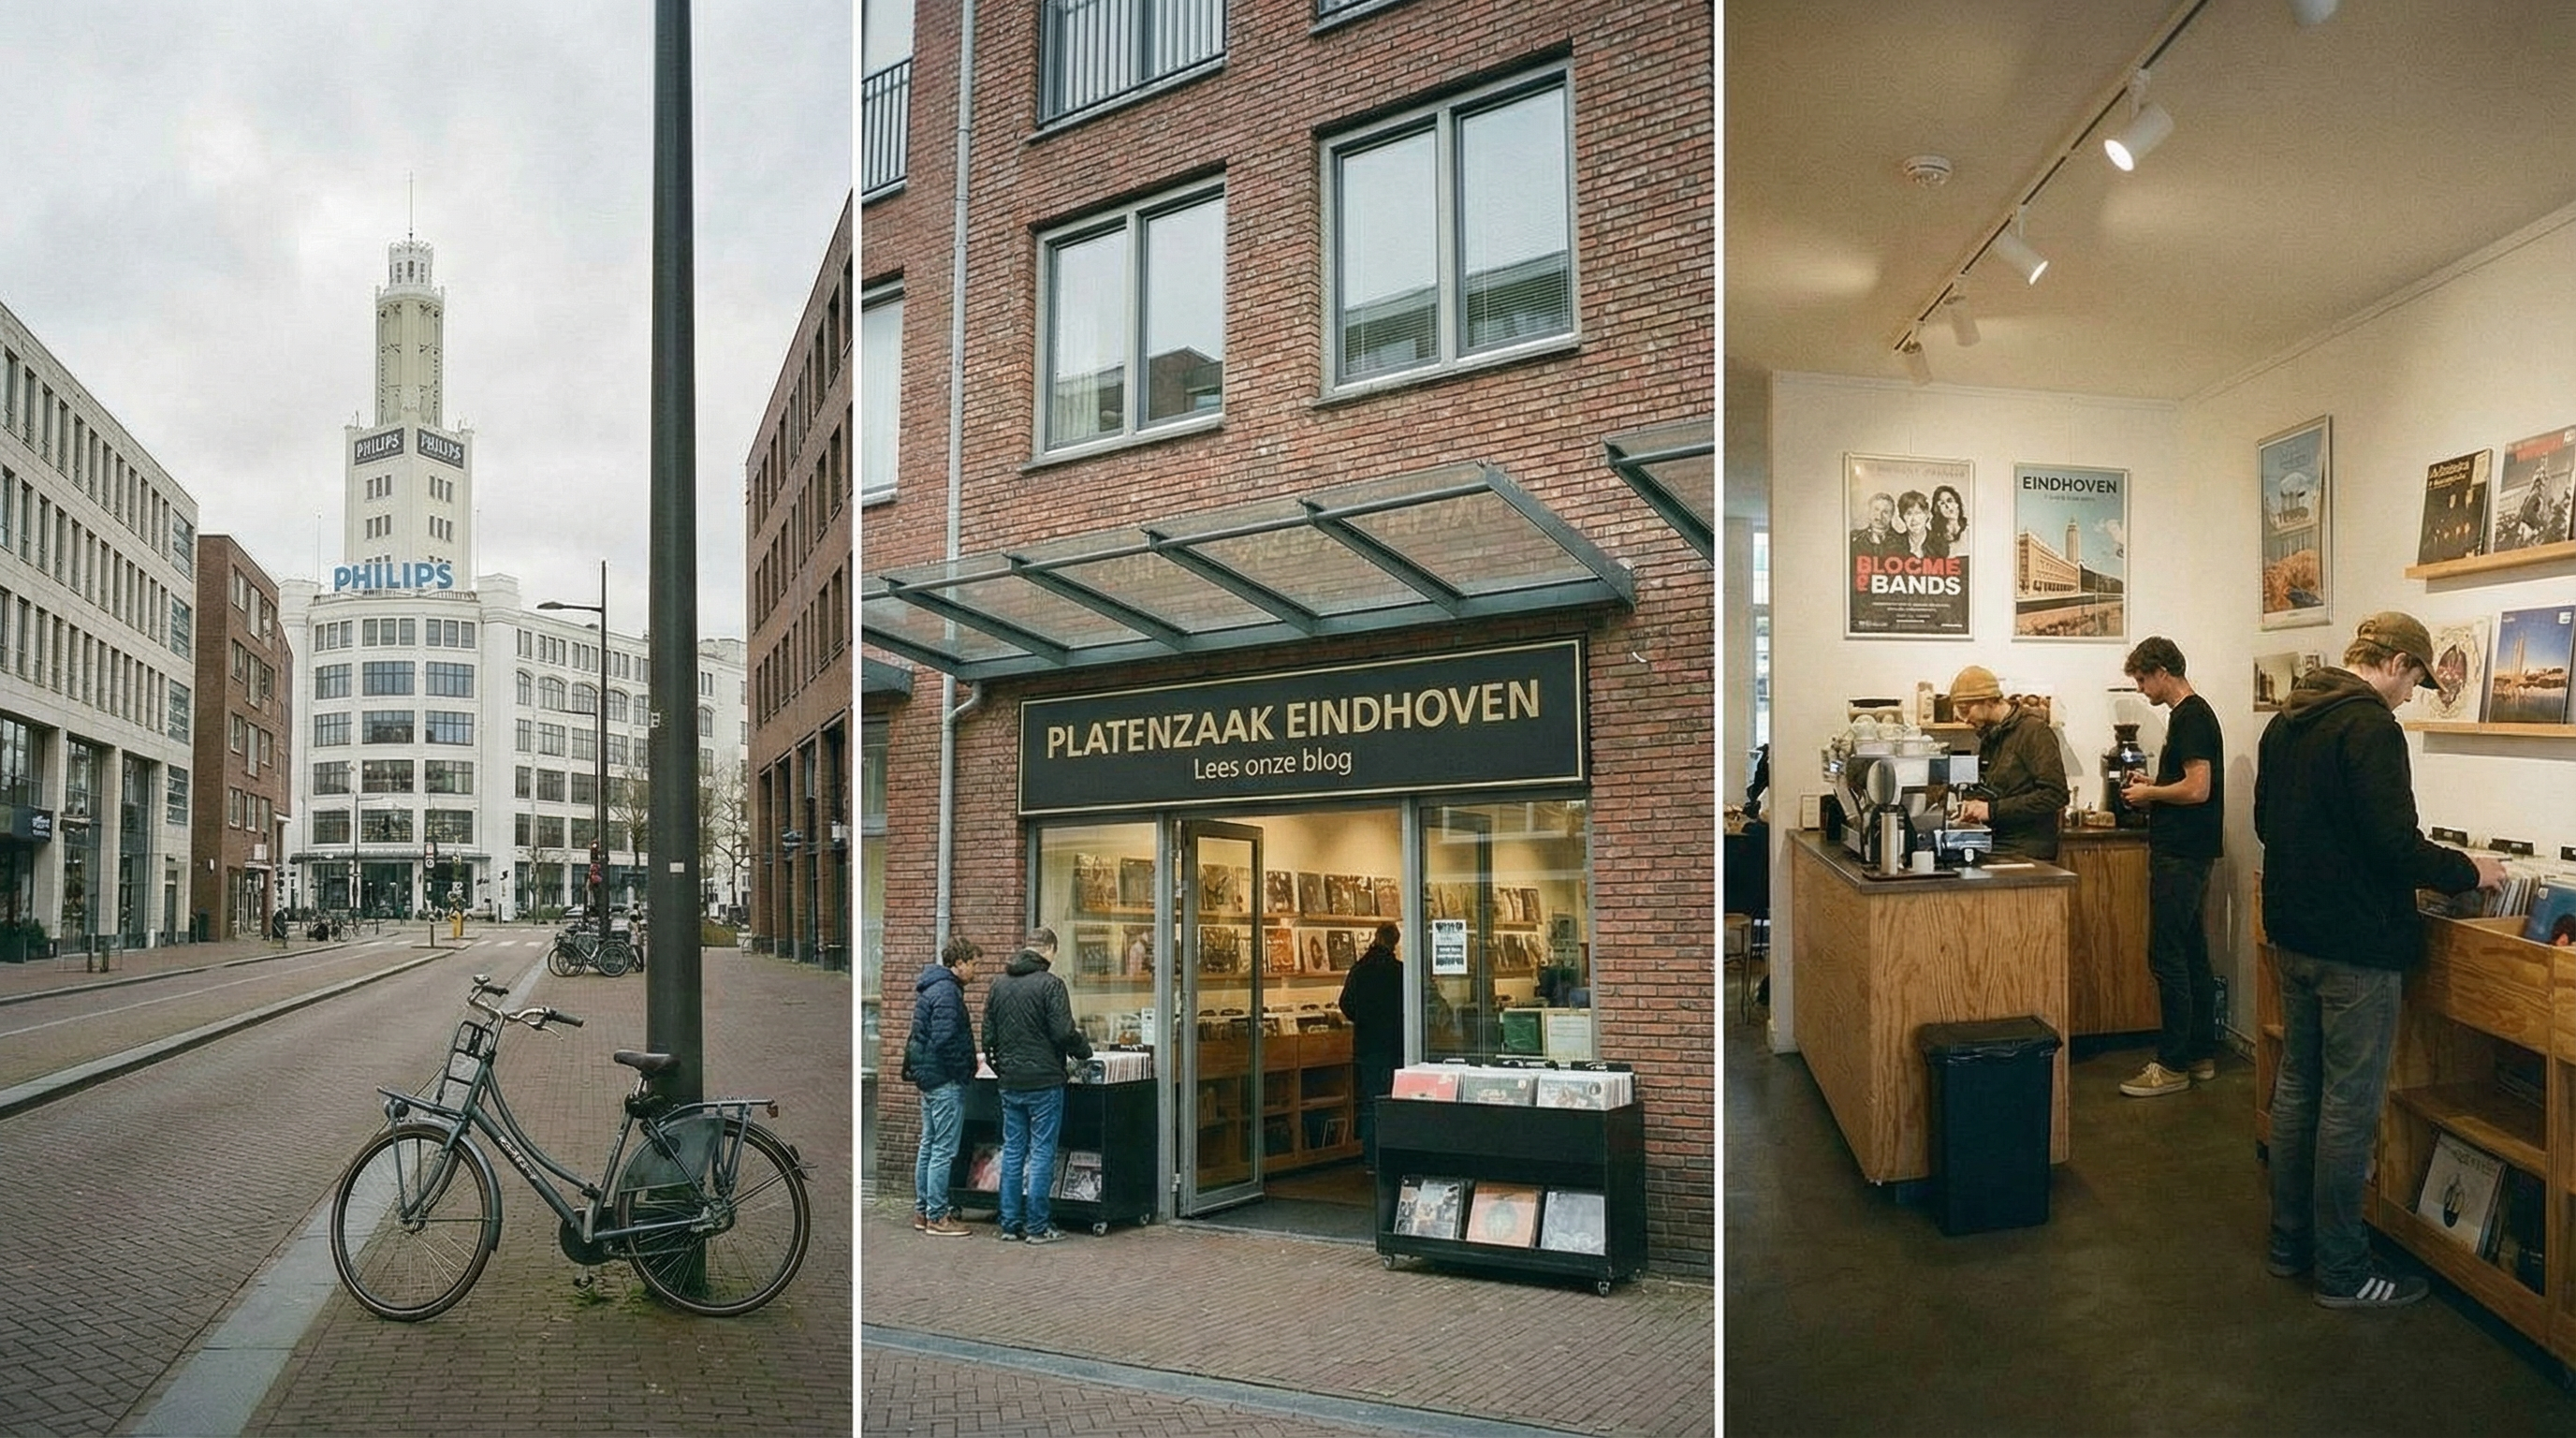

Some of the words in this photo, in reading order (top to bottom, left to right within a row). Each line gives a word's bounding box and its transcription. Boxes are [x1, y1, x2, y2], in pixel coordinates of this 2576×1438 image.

[357, 433, 400, 458] PHILIPS
[420, 433, 461, 460] PHILIPS
[2022, 475, 2117, 494] EINDHOVEN
[334, 562, 454, 592] PHILIPS
[1871, 574, 1962, 595] BANDS
[1046, 705, 1275, 759] PLATENZAAK
[1286, 679, 1541, 740] EINDHOVEN
[1194, 758, 1239, 780] Lees
[1245, 755, 1296, 777] onze
[1302, 747, 1353, 776] blog
